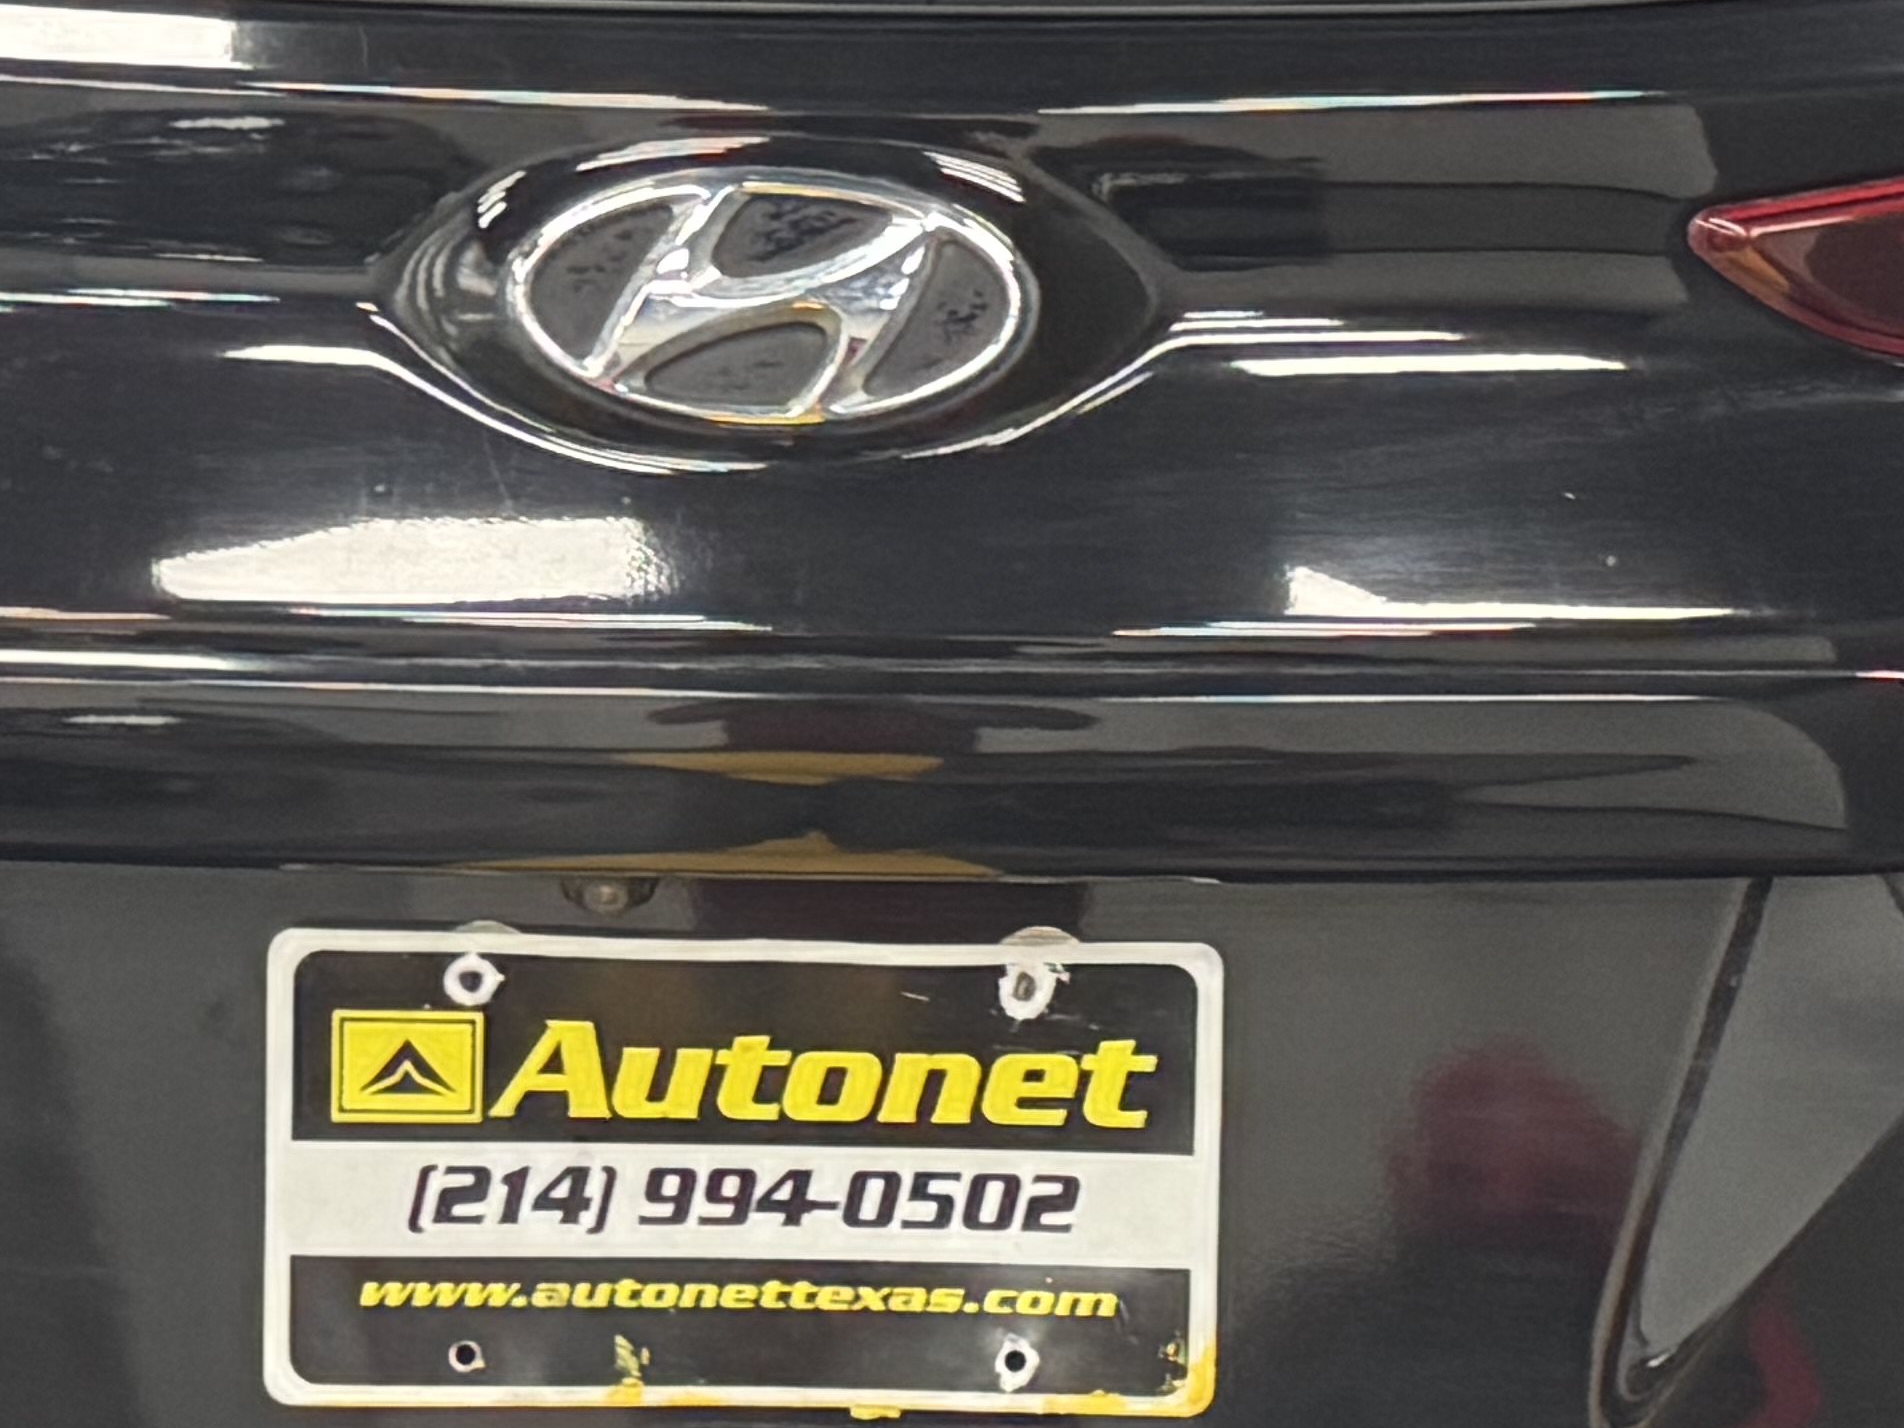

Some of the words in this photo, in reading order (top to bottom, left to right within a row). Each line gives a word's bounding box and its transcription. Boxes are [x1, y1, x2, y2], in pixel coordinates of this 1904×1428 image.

[490, 1019, 1159, 1129] Autonet
[408, 1165, 616, 1234] (214)
[637, 1169, 1082, 1234] 994-0502
[359, 1277, 1119, 1319] www.autonettexas.com
